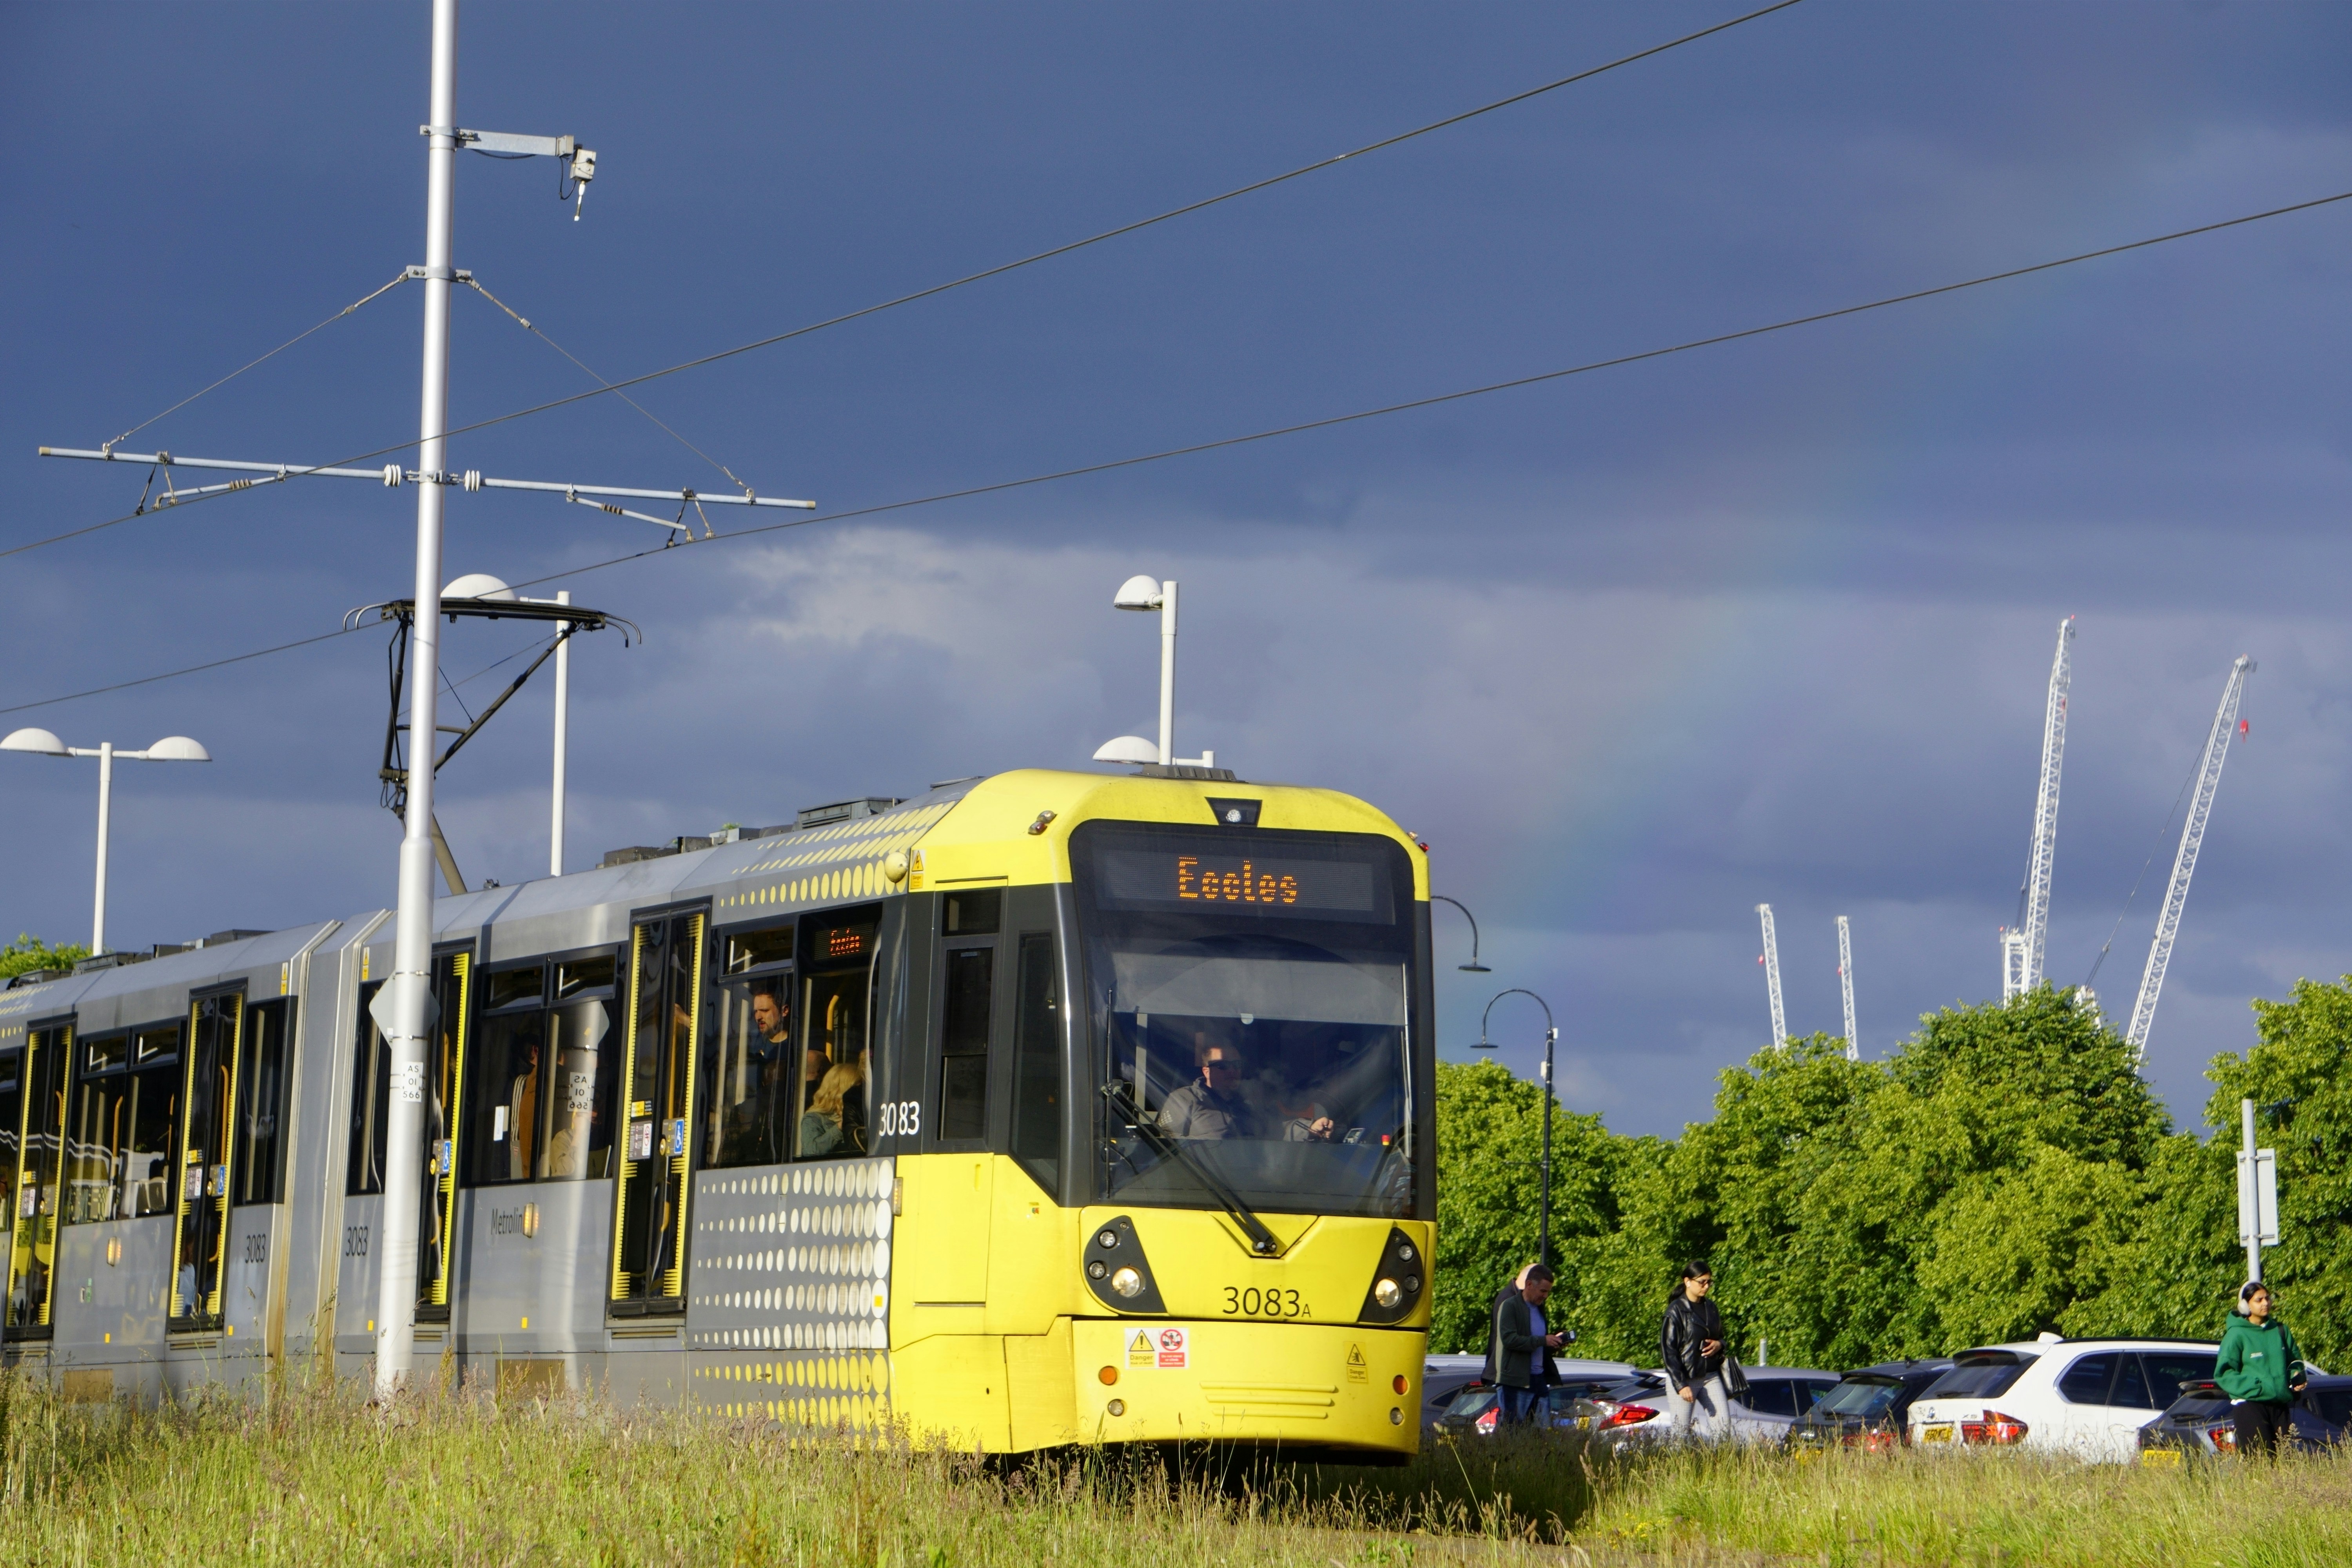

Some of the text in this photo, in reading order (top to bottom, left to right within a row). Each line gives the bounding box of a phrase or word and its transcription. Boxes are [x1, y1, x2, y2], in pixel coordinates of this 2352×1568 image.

[1179, 857, 1297, 903] Eccles
[879, 1101, 920, 1137] 3083
[491, 1207, 523, 1235] Metrolin
[245, 1233, 266, 1263] 3083
[346, 1226, 368, 1256] 3083
